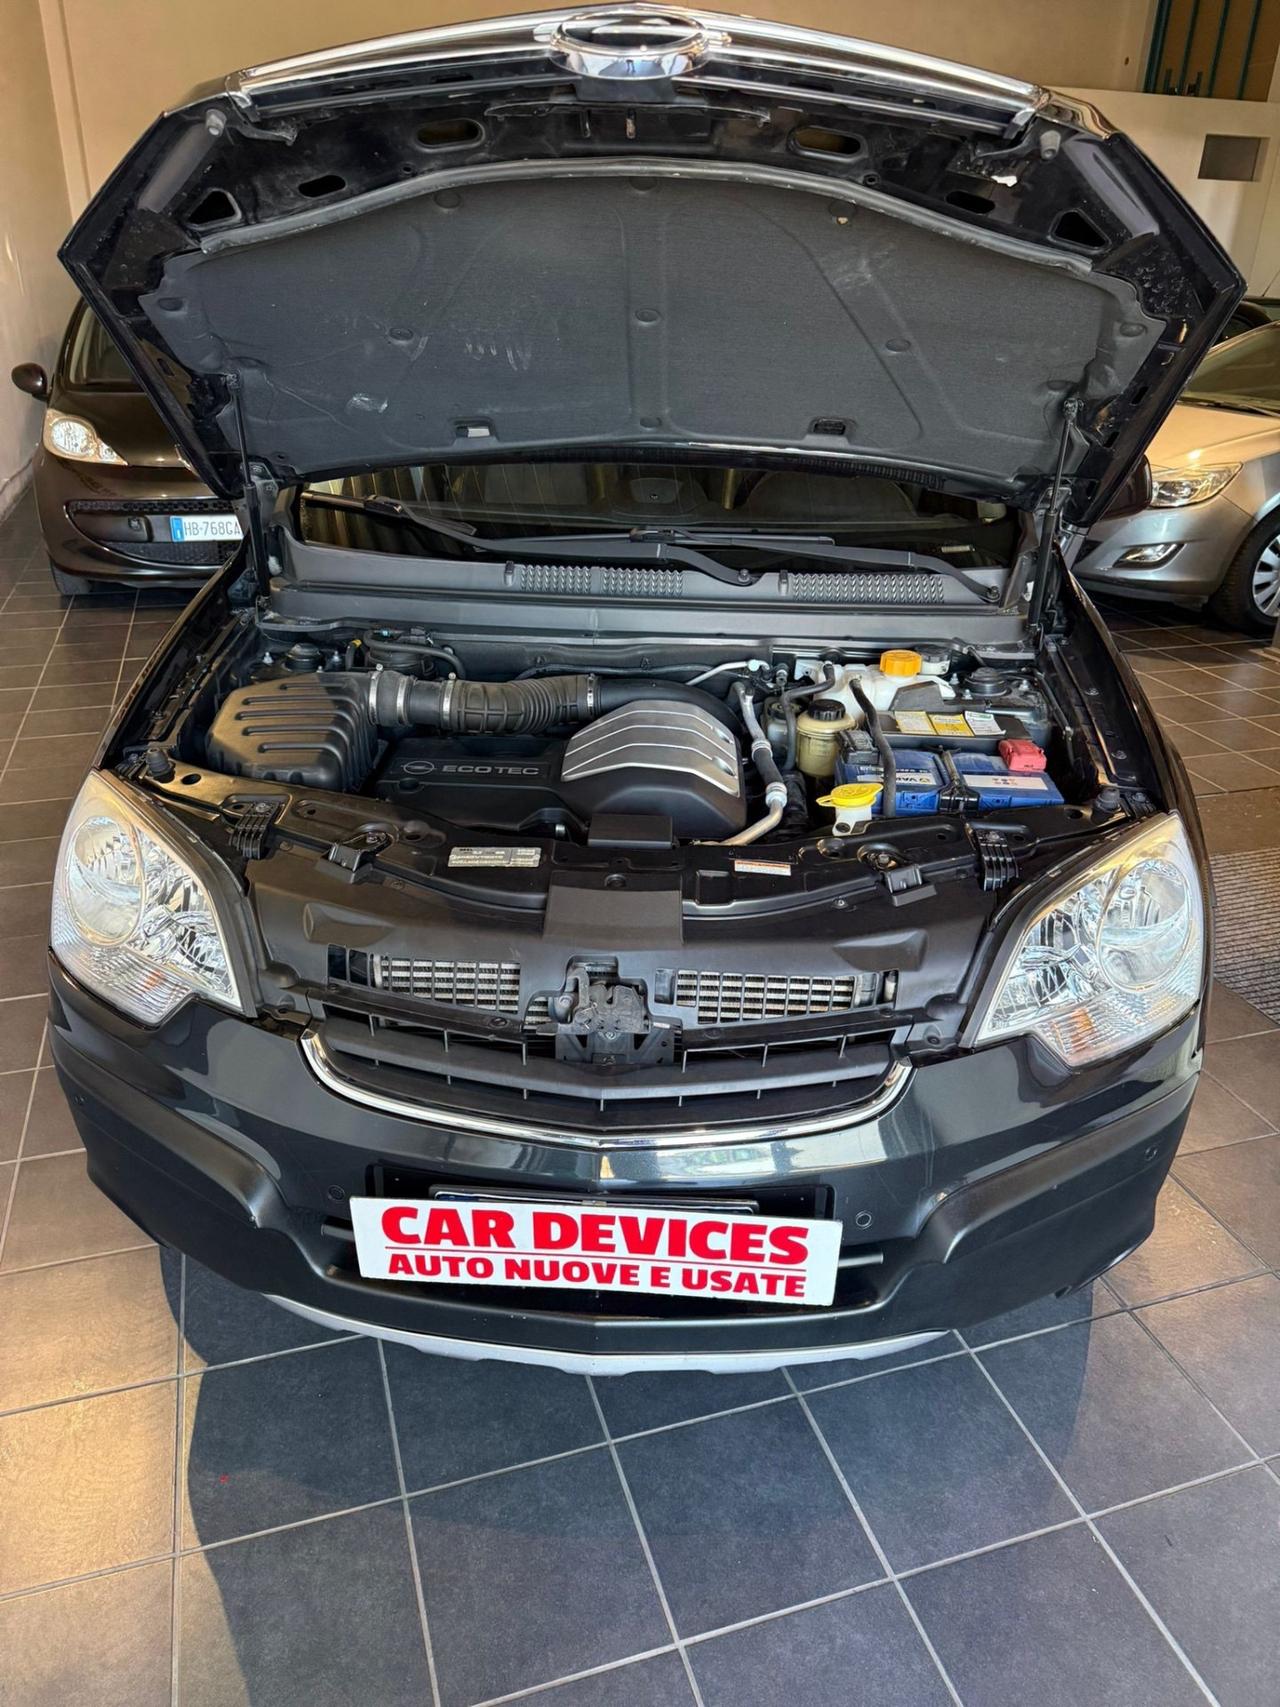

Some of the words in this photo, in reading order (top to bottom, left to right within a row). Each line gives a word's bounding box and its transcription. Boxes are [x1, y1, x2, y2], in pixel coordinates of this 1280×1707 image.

[442, 765, 540, 775] ECOTEC
[381, 1206, 515, 1248] CAR
[532, 1212, 809, 1265] DEVICES
[389, 1253, 494, 1278] AUTO
[504, 1259, 639, 1286] NUOVE
[651, 1266, 671, 1288] E
[682, 1268, 806, 1297] USATE
